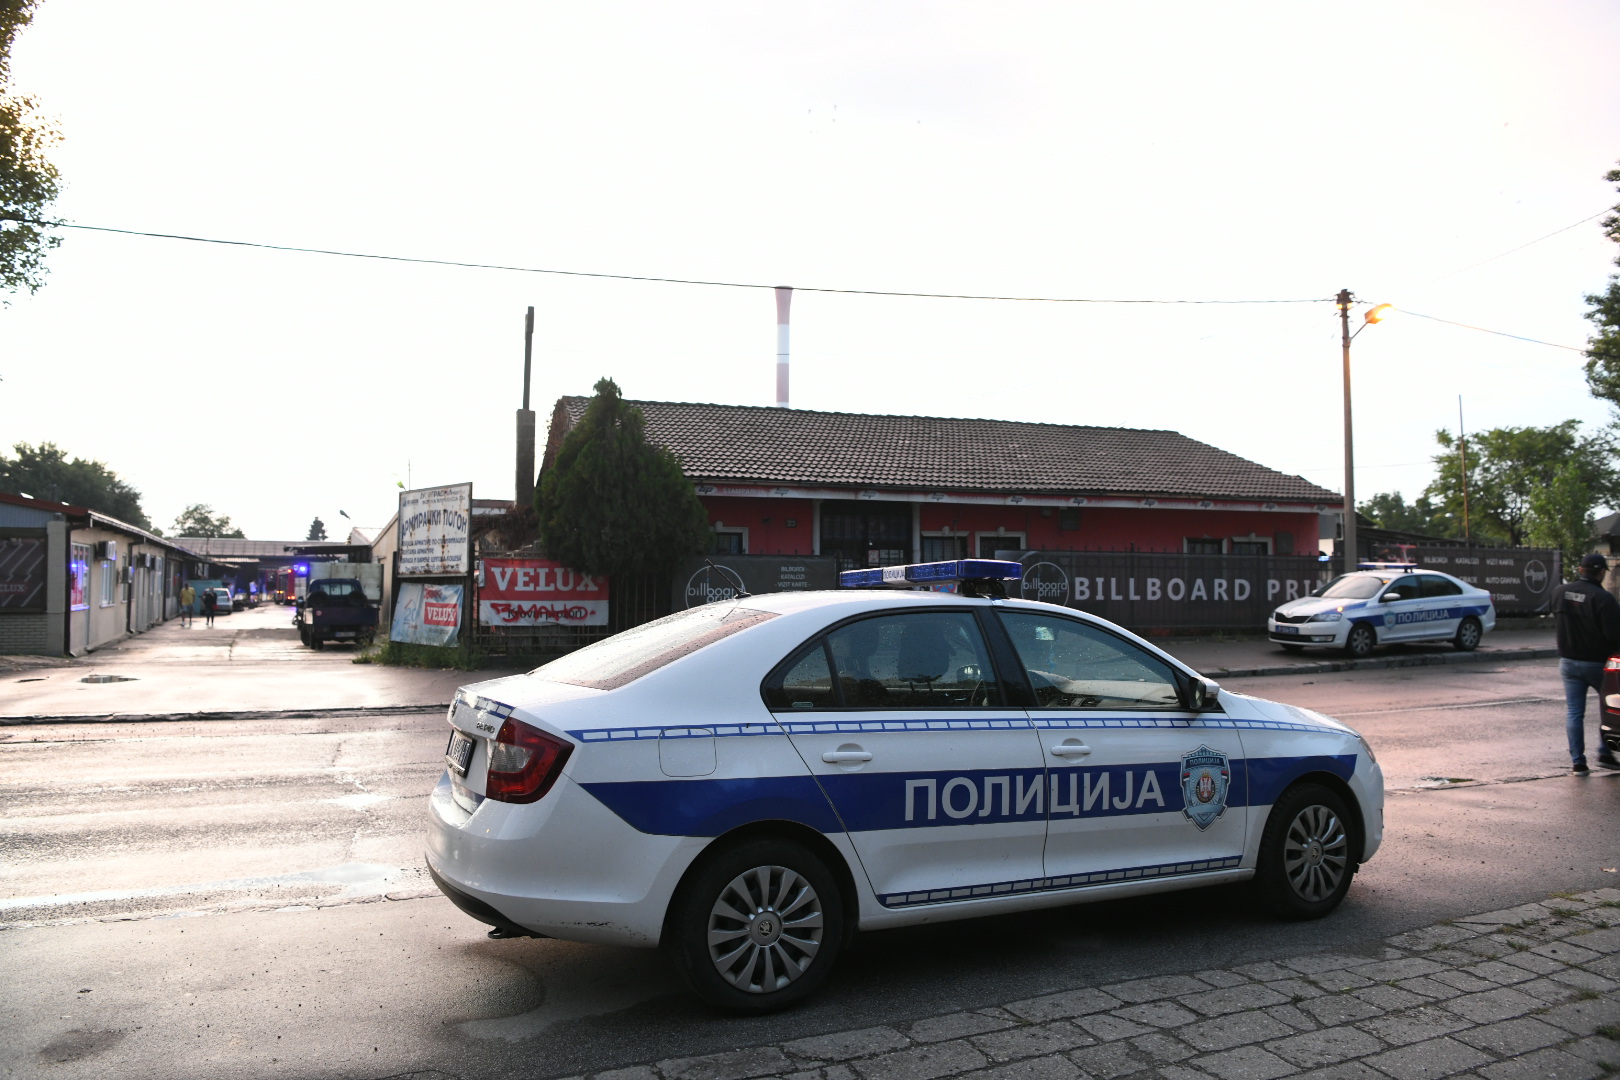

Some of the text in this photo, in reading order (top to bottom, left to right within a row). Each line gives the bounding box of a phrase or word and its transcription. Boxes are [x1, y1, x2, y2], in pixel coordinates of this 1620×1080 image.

[443, 509, 467, 534] ПОГОН
[787, 519, 796, 527] 23
[491, 567, 599, 591] VELUX
[1022, 577, 1067, 590] billboard
[1038, 588, 1060, 602] print
[1075, 577, 1251, 601] BILLBOARD
[427, 606, 455, 622] VELUX
[1398, 609, 1449, 623] ПОЛИЦИЈА
[1190, 757, 1221, 765] ПОЛИЦИЈА
[904, 770, 1166, 822] ПОЛИЦИЈА
